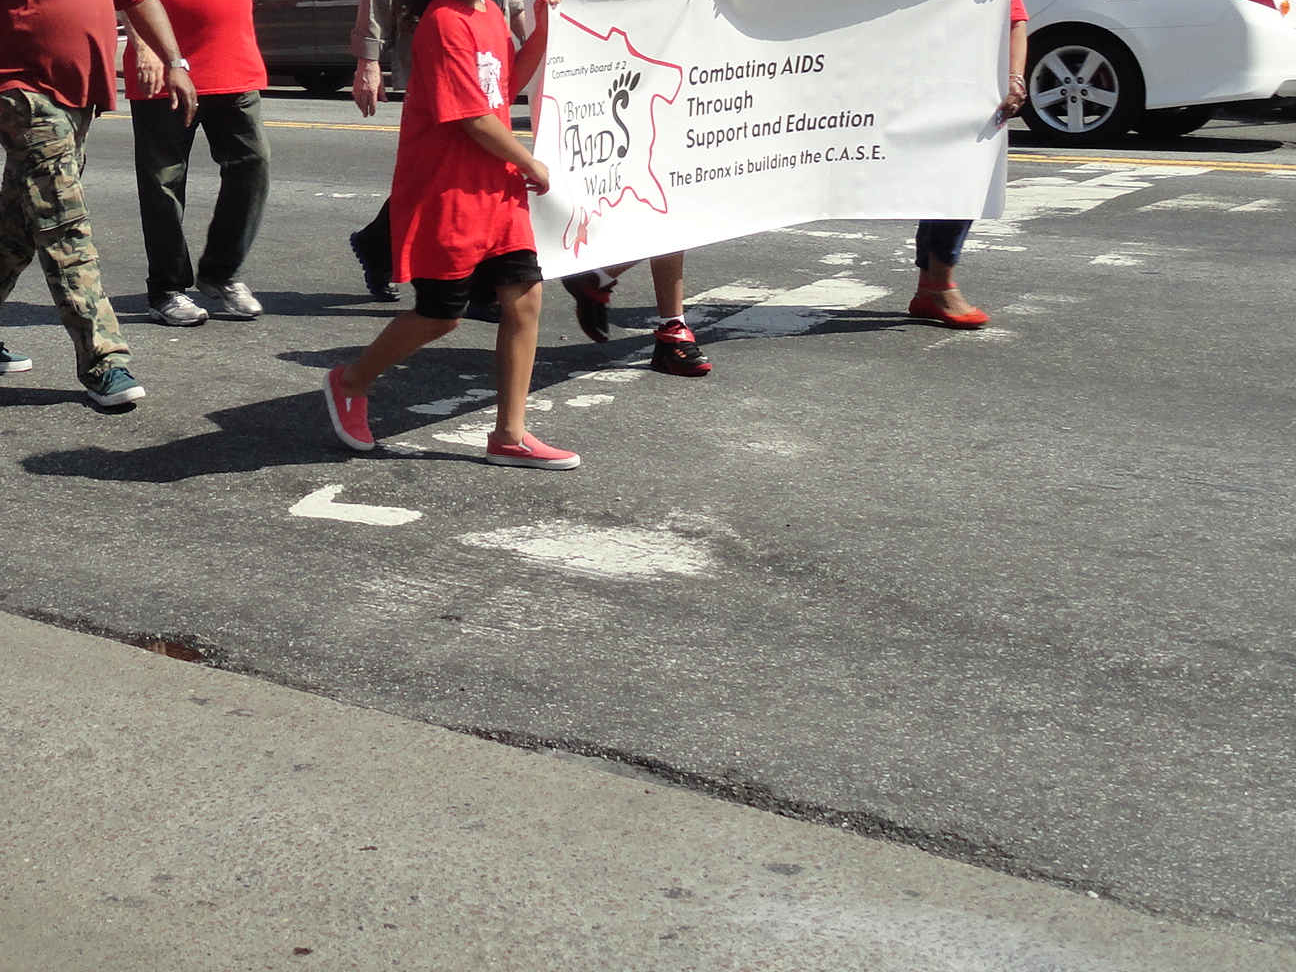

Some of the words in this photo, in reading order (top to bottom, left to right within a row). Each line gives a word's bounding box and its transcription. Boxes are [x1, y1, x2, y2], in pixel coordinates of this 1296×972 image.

[552, 64, 589, 79] Community
[589, 62, 612, 74] Board
[689, 59, 778, 85] Combating
[780, 54, 825, 75] AIDS
[564, 100, 606, 122] Bronx
[687, 90, 753, 117] Through
[564, 89, 630, 172] AIDS
[686, 122, 749, 148] Support
[752, 116, 781, 137] and
[786, 110, 874, 133] Education
[584, 162, 622, 197] Walk
[669, 171, 692, 187] The
[695, 165, 732, 183] Bronx
[734, 161, 744, 176] is
[747, 153, 796, 174] building
[800, 149, 822, 165] the
[825, 145, 886, 162] C.A.S.E.
